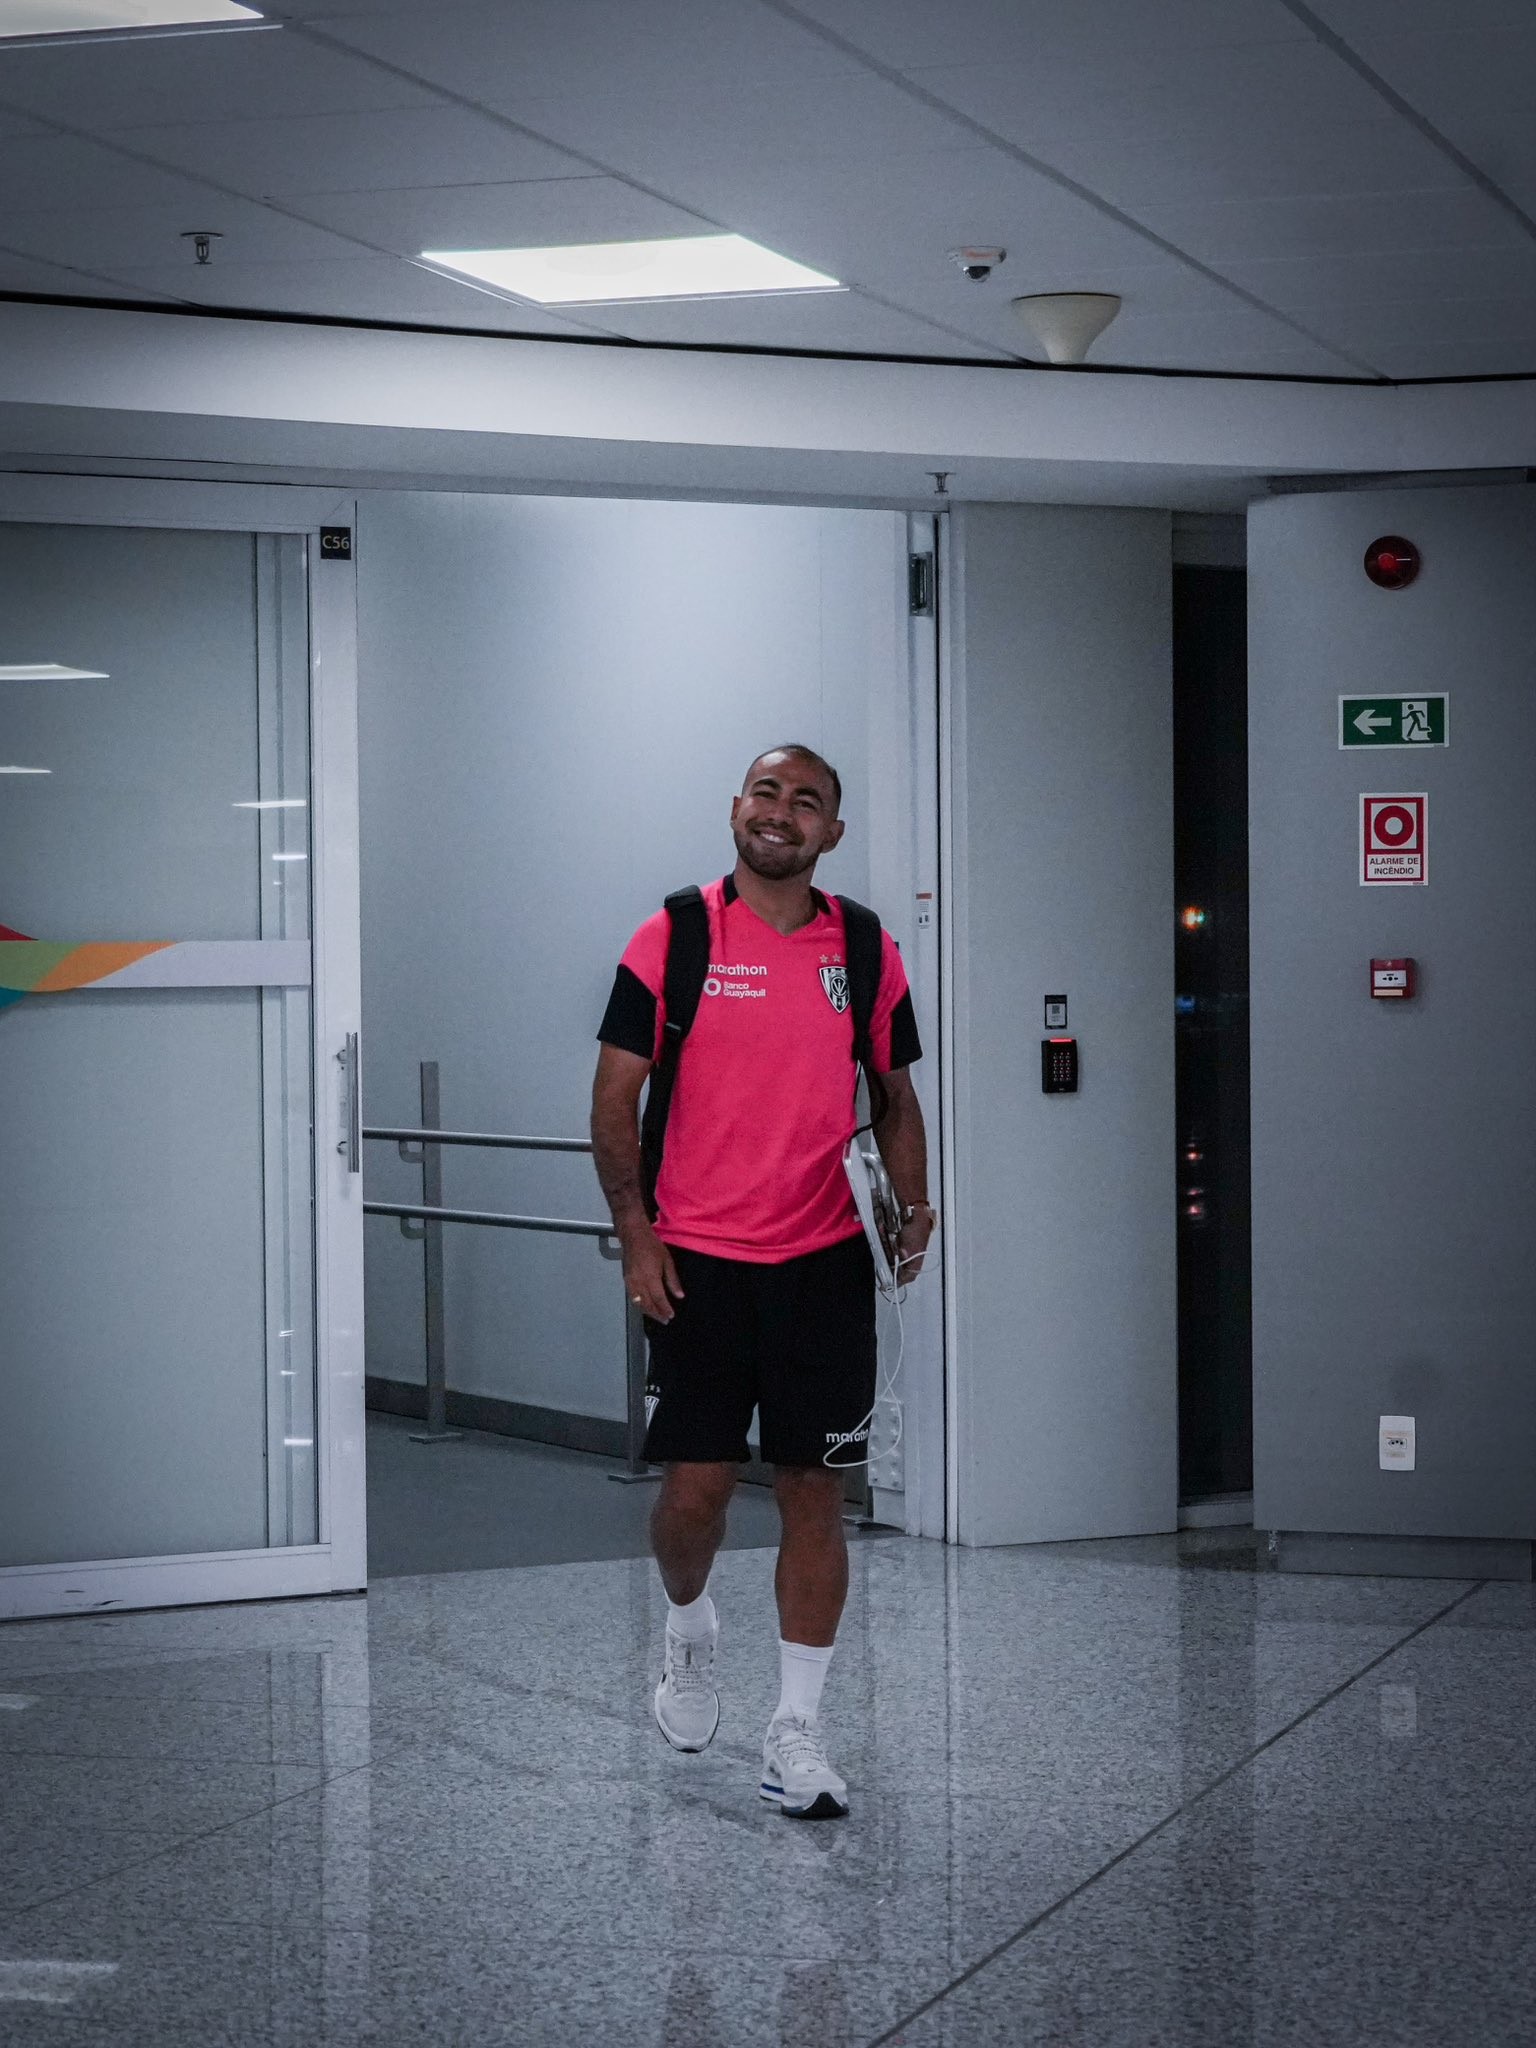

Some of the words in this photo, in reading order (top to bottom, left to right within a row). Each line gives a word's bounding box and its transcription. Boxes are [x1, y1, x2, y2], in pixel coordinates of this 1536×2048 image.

[322, 535, 350, 549] C56
[1369, 857, 1404, 865] ALARME
[1407, 857, 1419, 865] DE
[1374, 866, 1414, 875] INCÊNDIO
